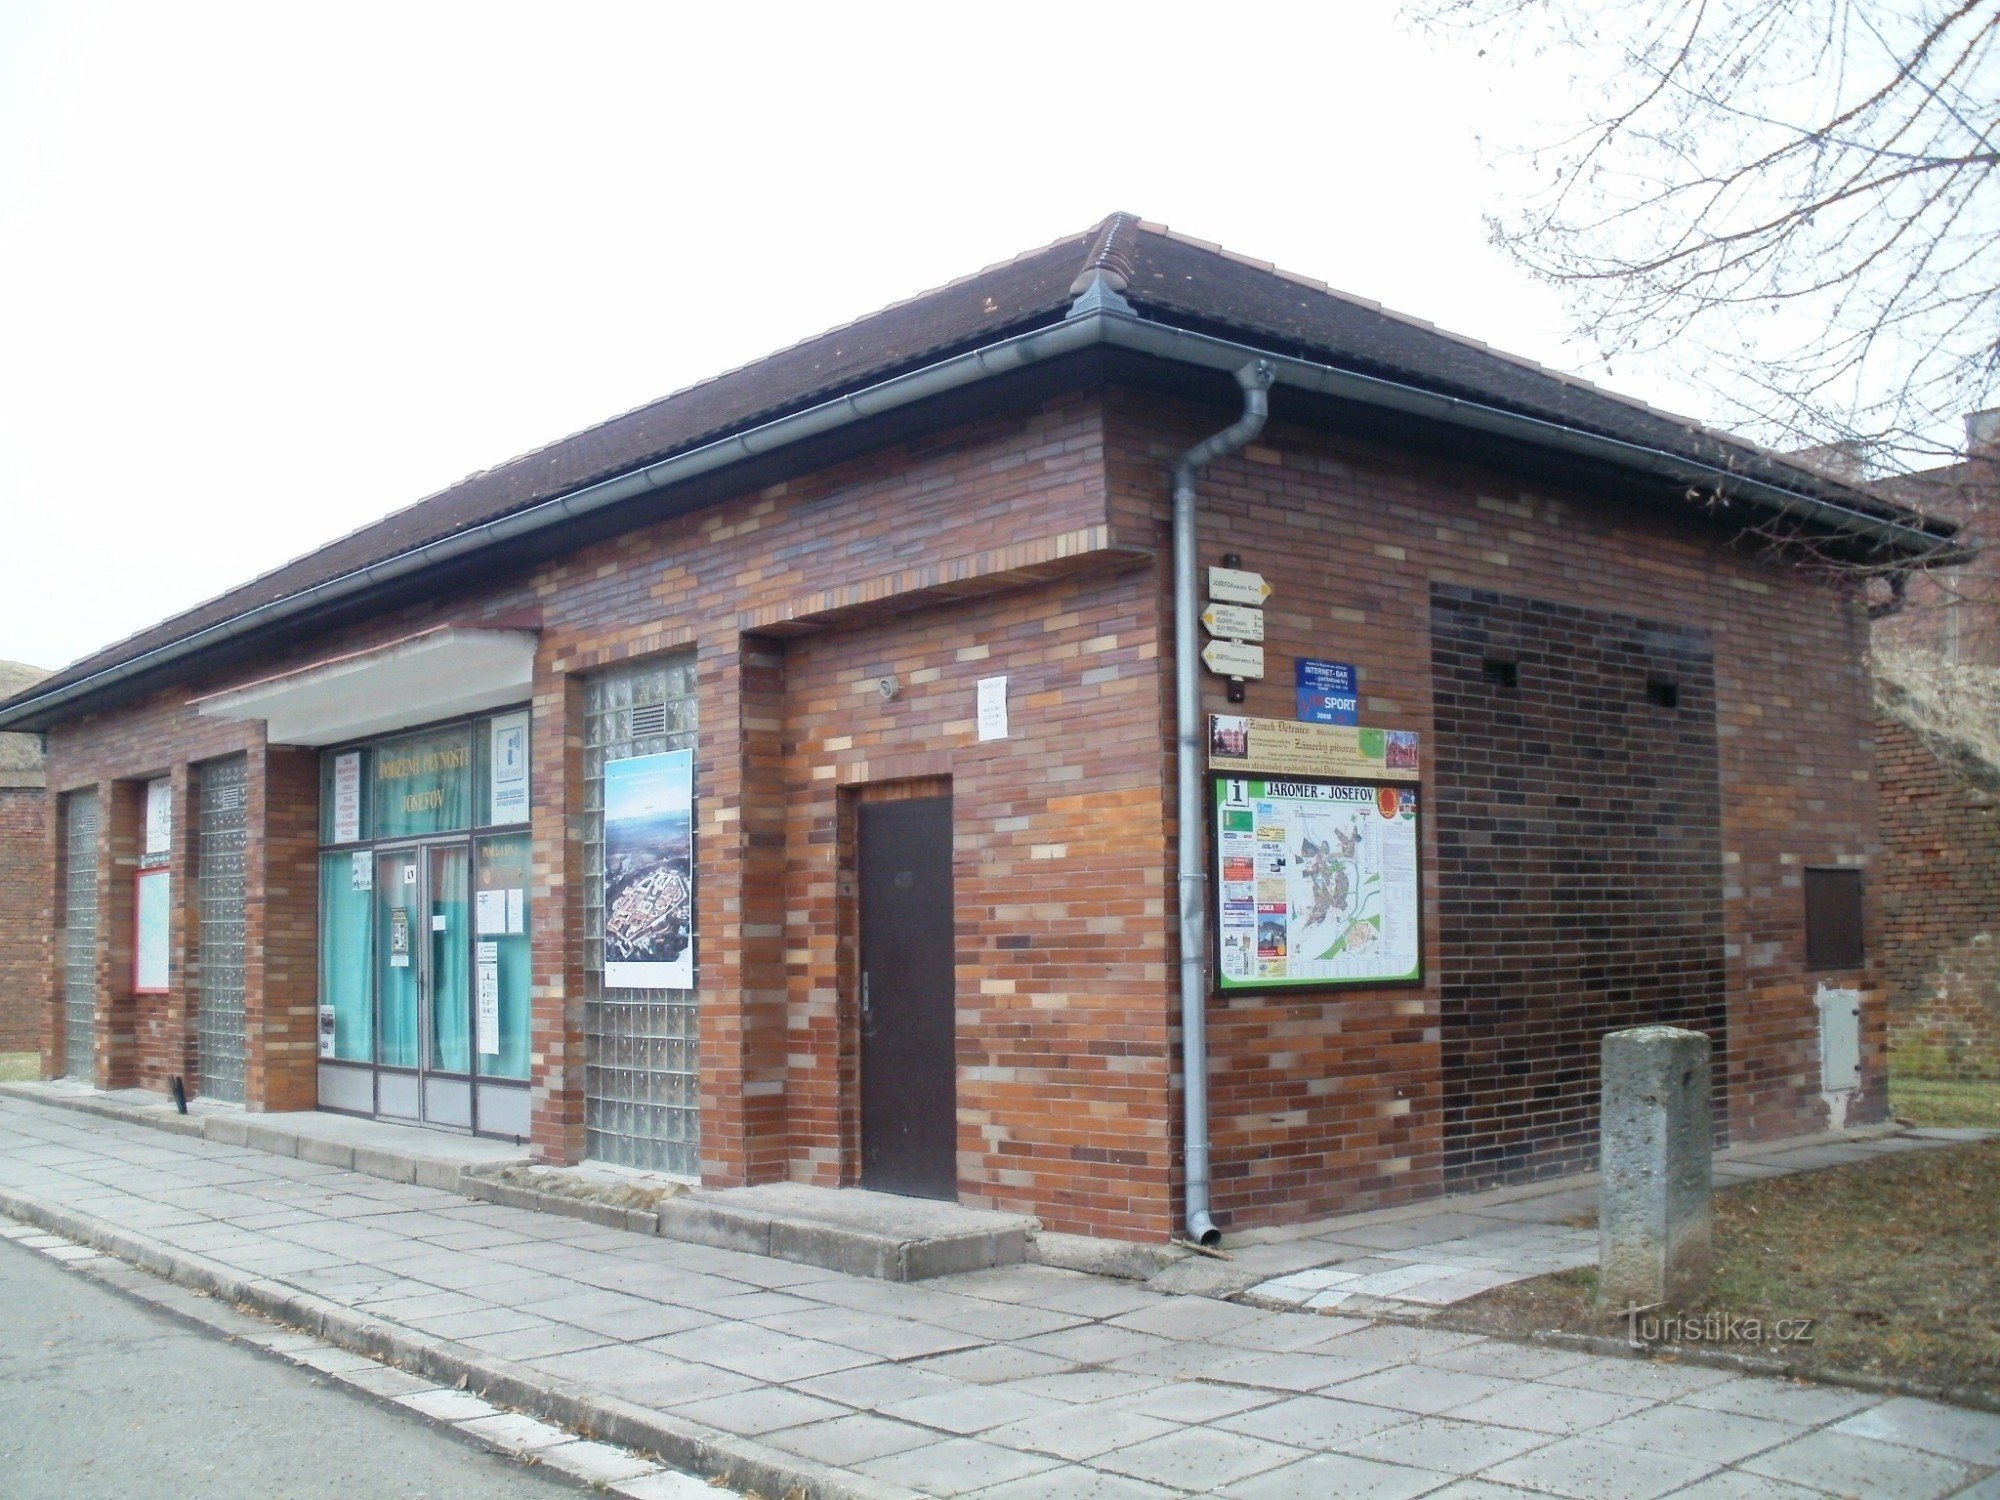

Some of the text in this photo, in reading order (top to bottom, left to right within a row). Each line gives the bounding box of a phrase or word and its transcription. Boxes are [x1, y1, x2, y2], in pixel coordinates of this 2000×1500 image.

[1324, 697, 1357, 711] SPORT
[401, 788, 445, 813] JOSEFOV
[1328, 786, 1373, 801] JOSEFOV
